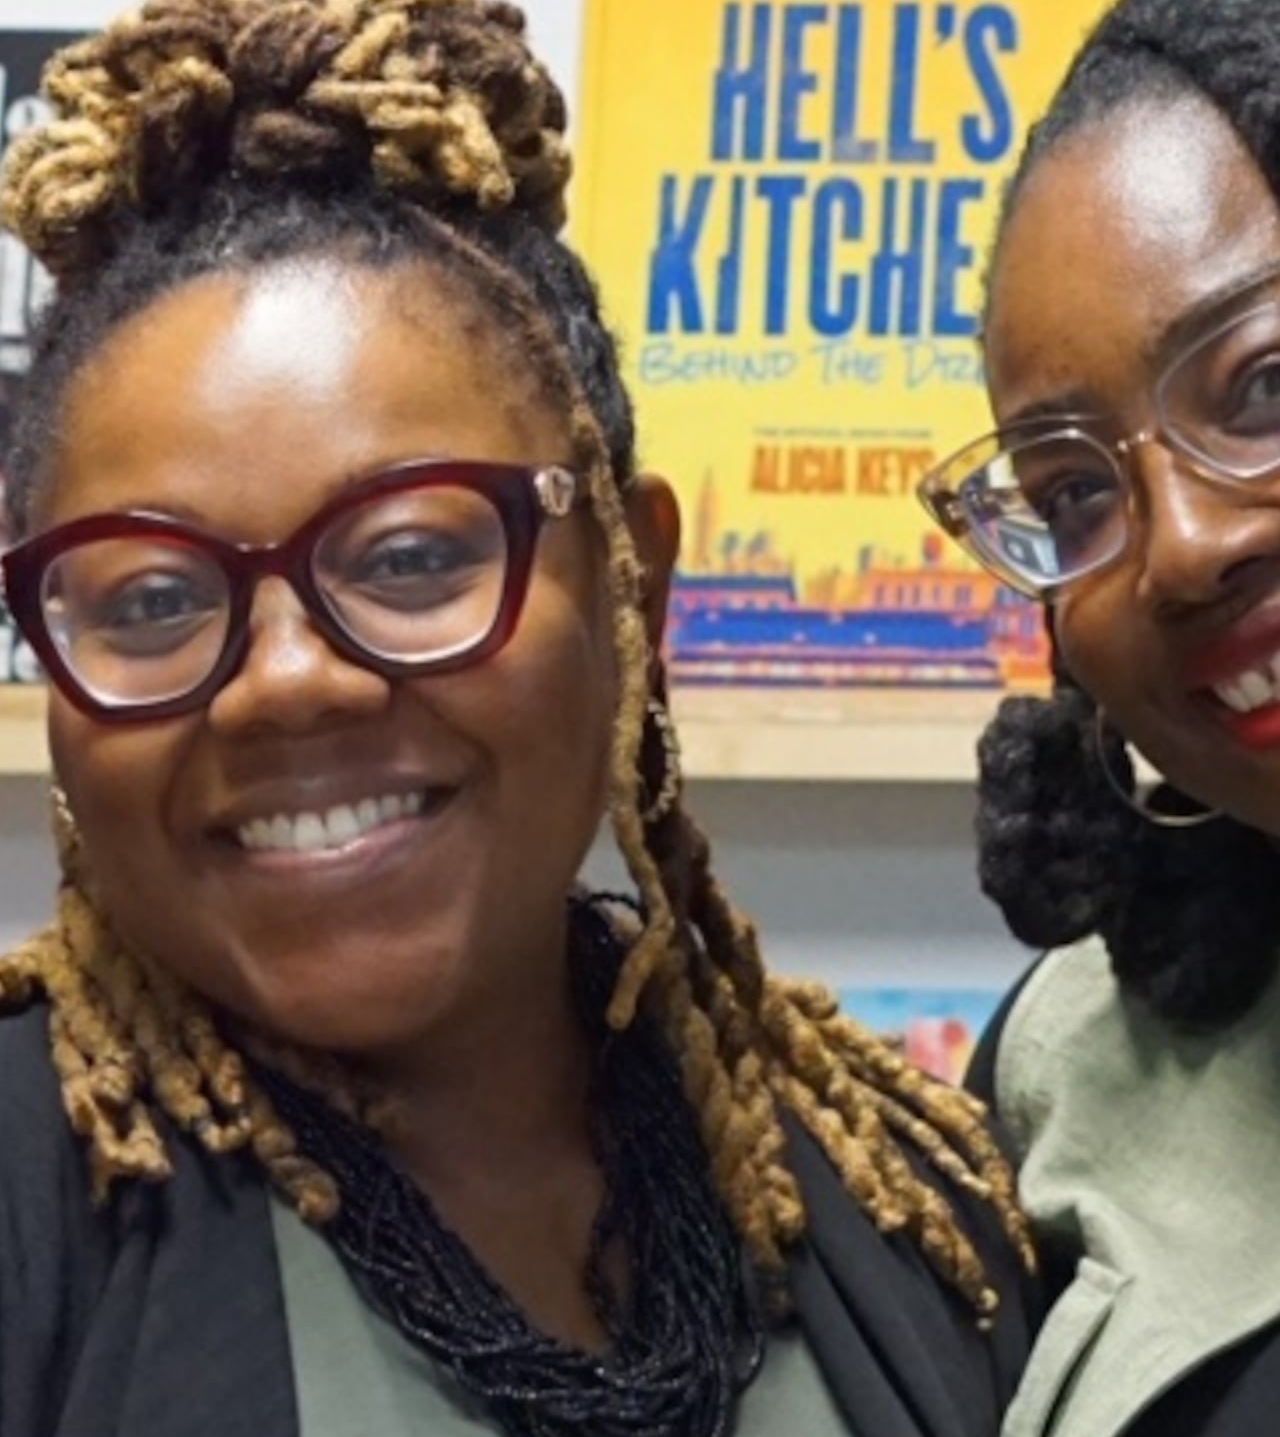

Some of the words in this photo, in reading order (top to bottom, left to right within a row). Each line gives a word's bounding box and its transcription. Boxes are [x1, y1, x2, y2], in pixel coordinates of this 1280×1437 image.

[710, 0, 1019, 165] HELL'S
[645, 175, 980, 339] KITCHE
[750, 445, 845, 494] ALICIA
